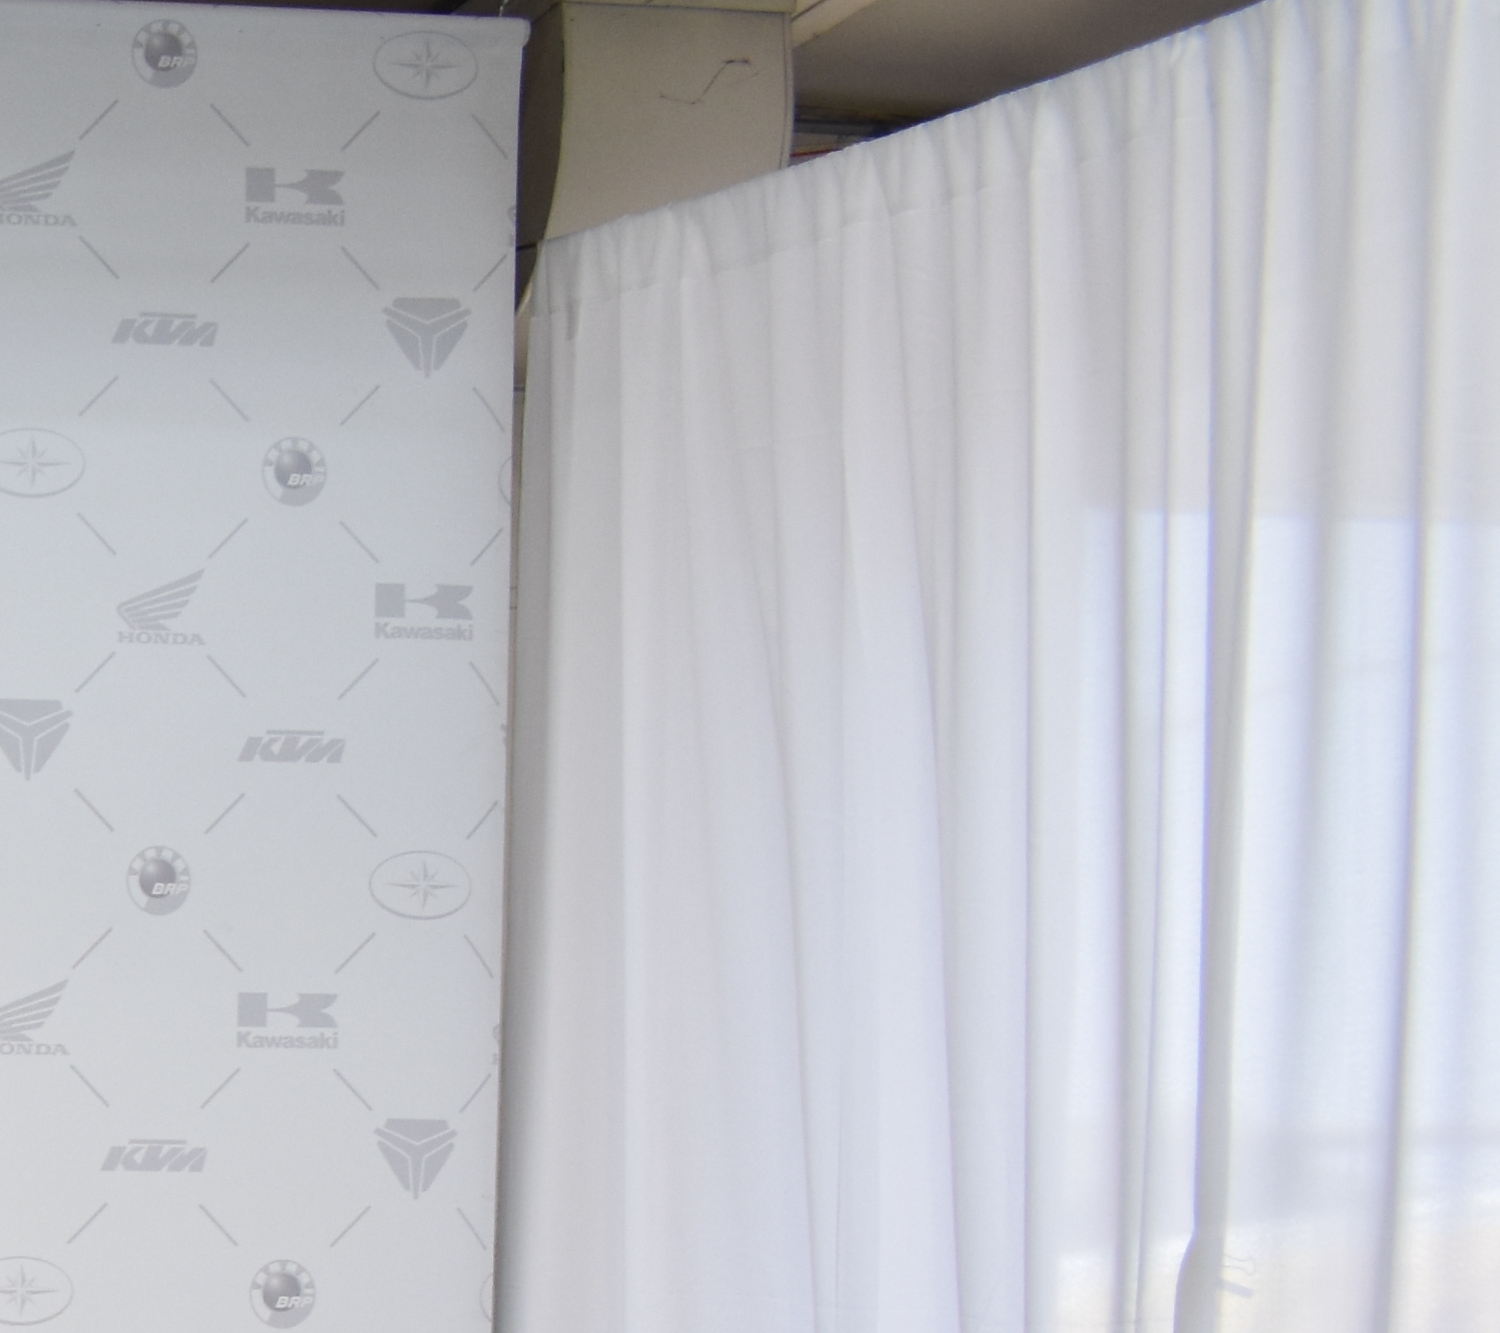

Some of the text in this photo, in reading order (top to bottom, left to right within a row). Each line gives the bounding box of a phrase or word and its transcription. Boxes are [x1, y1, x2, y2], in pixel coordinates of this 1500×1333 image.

[244, 203, 347, 229] Kawasaki
[109, 310, 221, 348] KTM
[116, 629, 207, 647] HONDA
[373, 618, 476, 644] Kawasaki
[236, 727, 348, 765] KTM
[234, 1028, 340, 1052] Kawasaki
[98, 1138, 210, 1174] KTM
